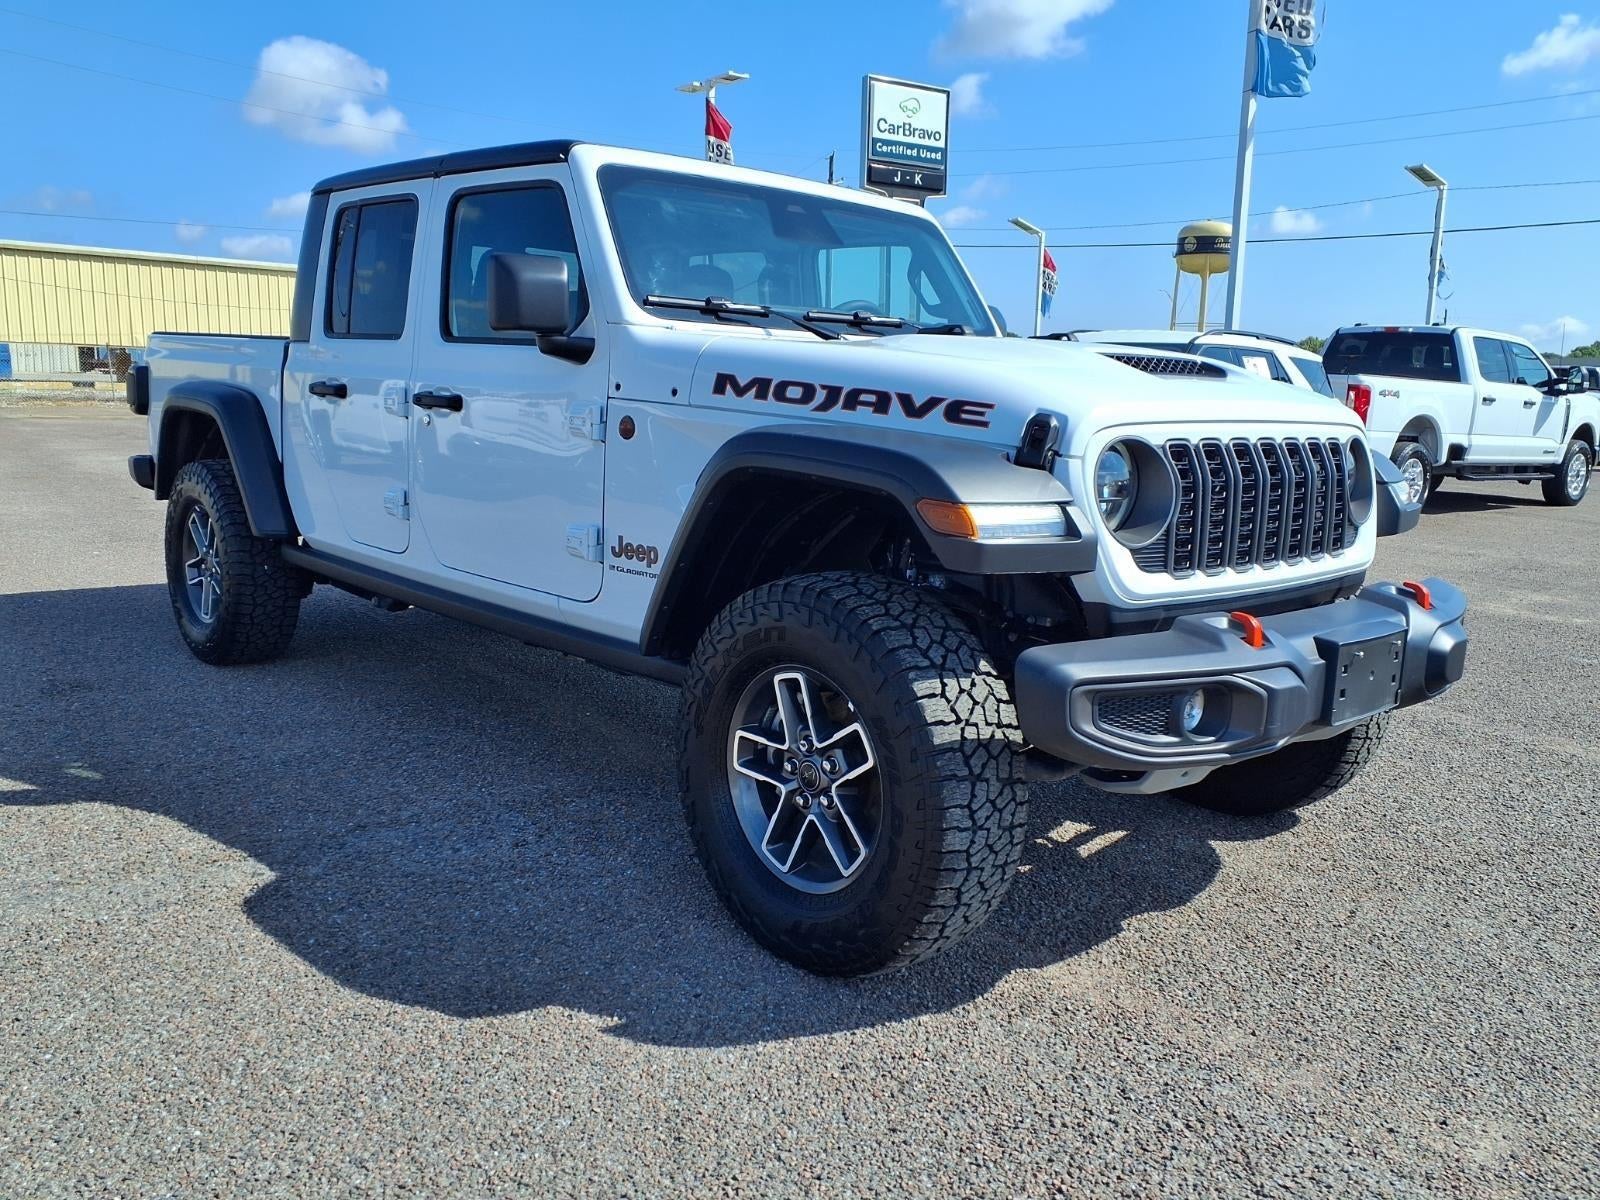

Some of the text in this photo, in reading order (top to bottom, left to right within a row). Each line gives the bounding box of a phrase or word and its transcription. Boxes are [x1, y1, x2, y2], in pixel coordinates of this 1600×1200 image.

[876, 117, 942, 142] CarBravo
[876, 143, 942, 160] Certified Used
[894, 171, 901, 182] J
[914, 173, 923, 185] K
[711, 372, 996, 429] MOJAVE
[610, 534, 659, 568] Jeep
